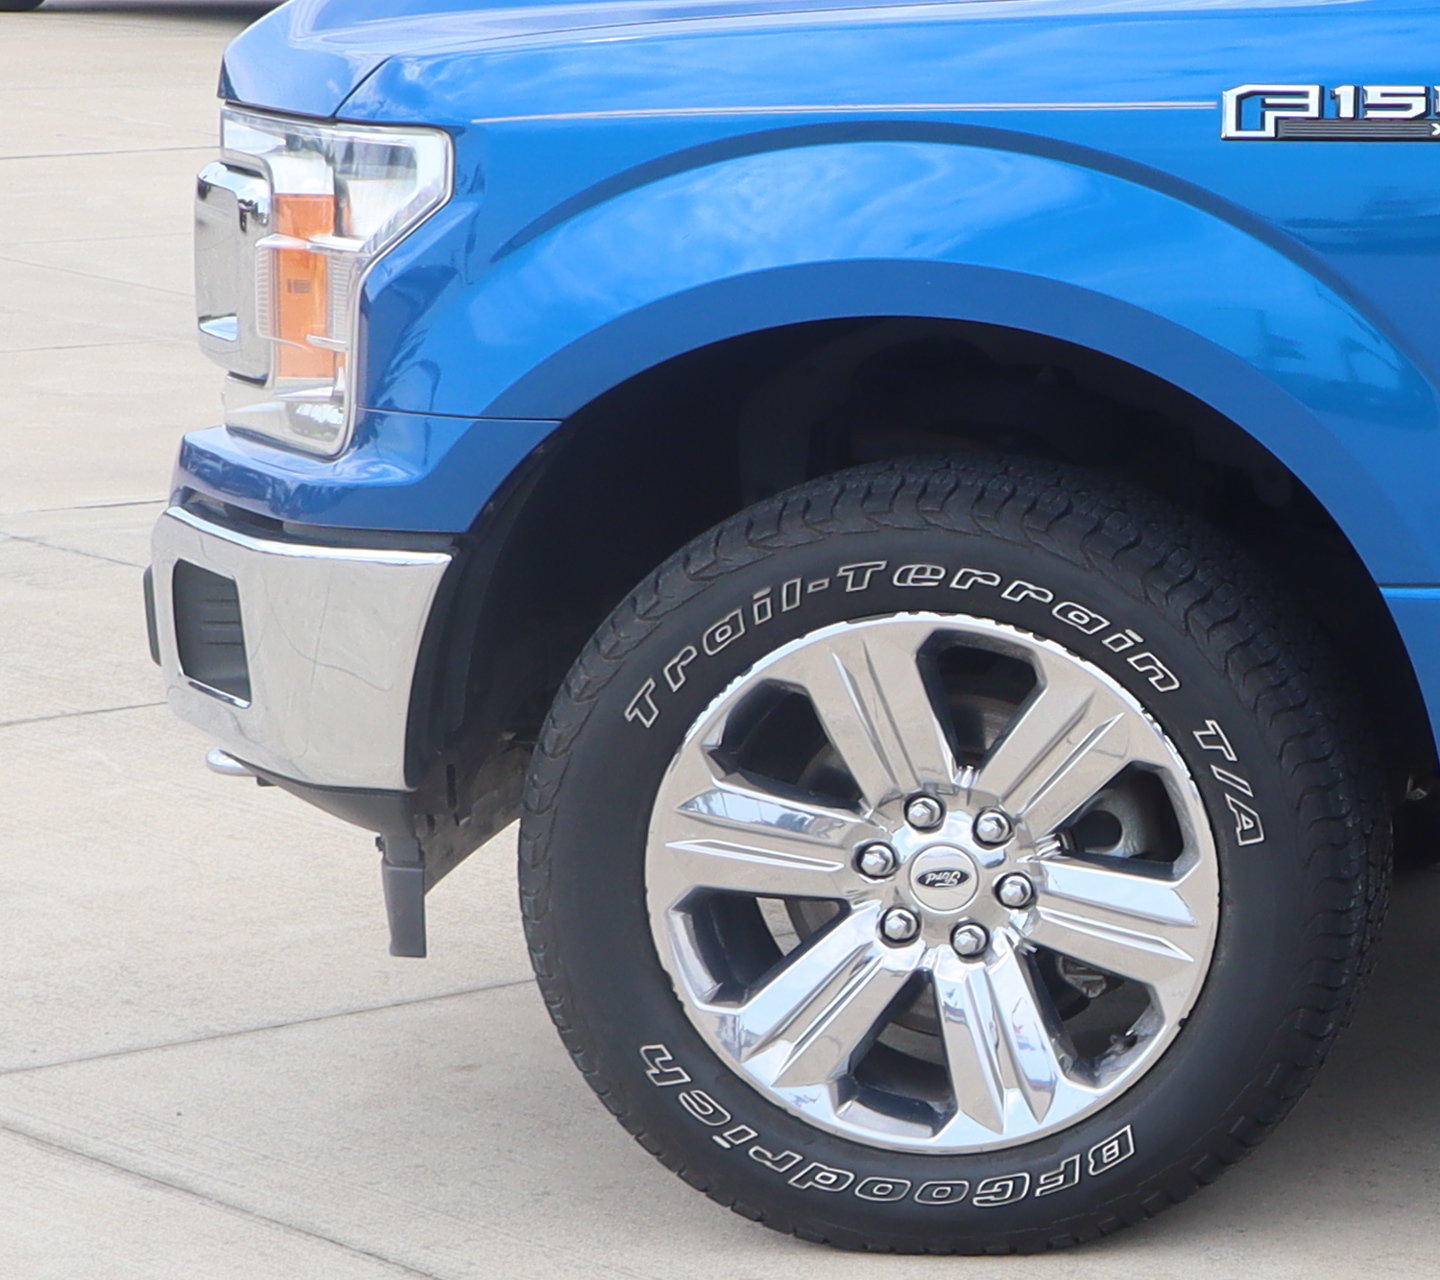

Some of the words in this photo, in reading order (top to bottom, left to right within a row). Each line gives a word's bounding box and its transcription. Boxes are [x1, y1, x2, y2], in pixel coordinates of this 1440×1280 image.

[624, 560, 1180, 728] Trail-Terrain
[1193, 719, 1265, 847] T/A
[639, 1043, 1136, 1208] BFGoodrich
